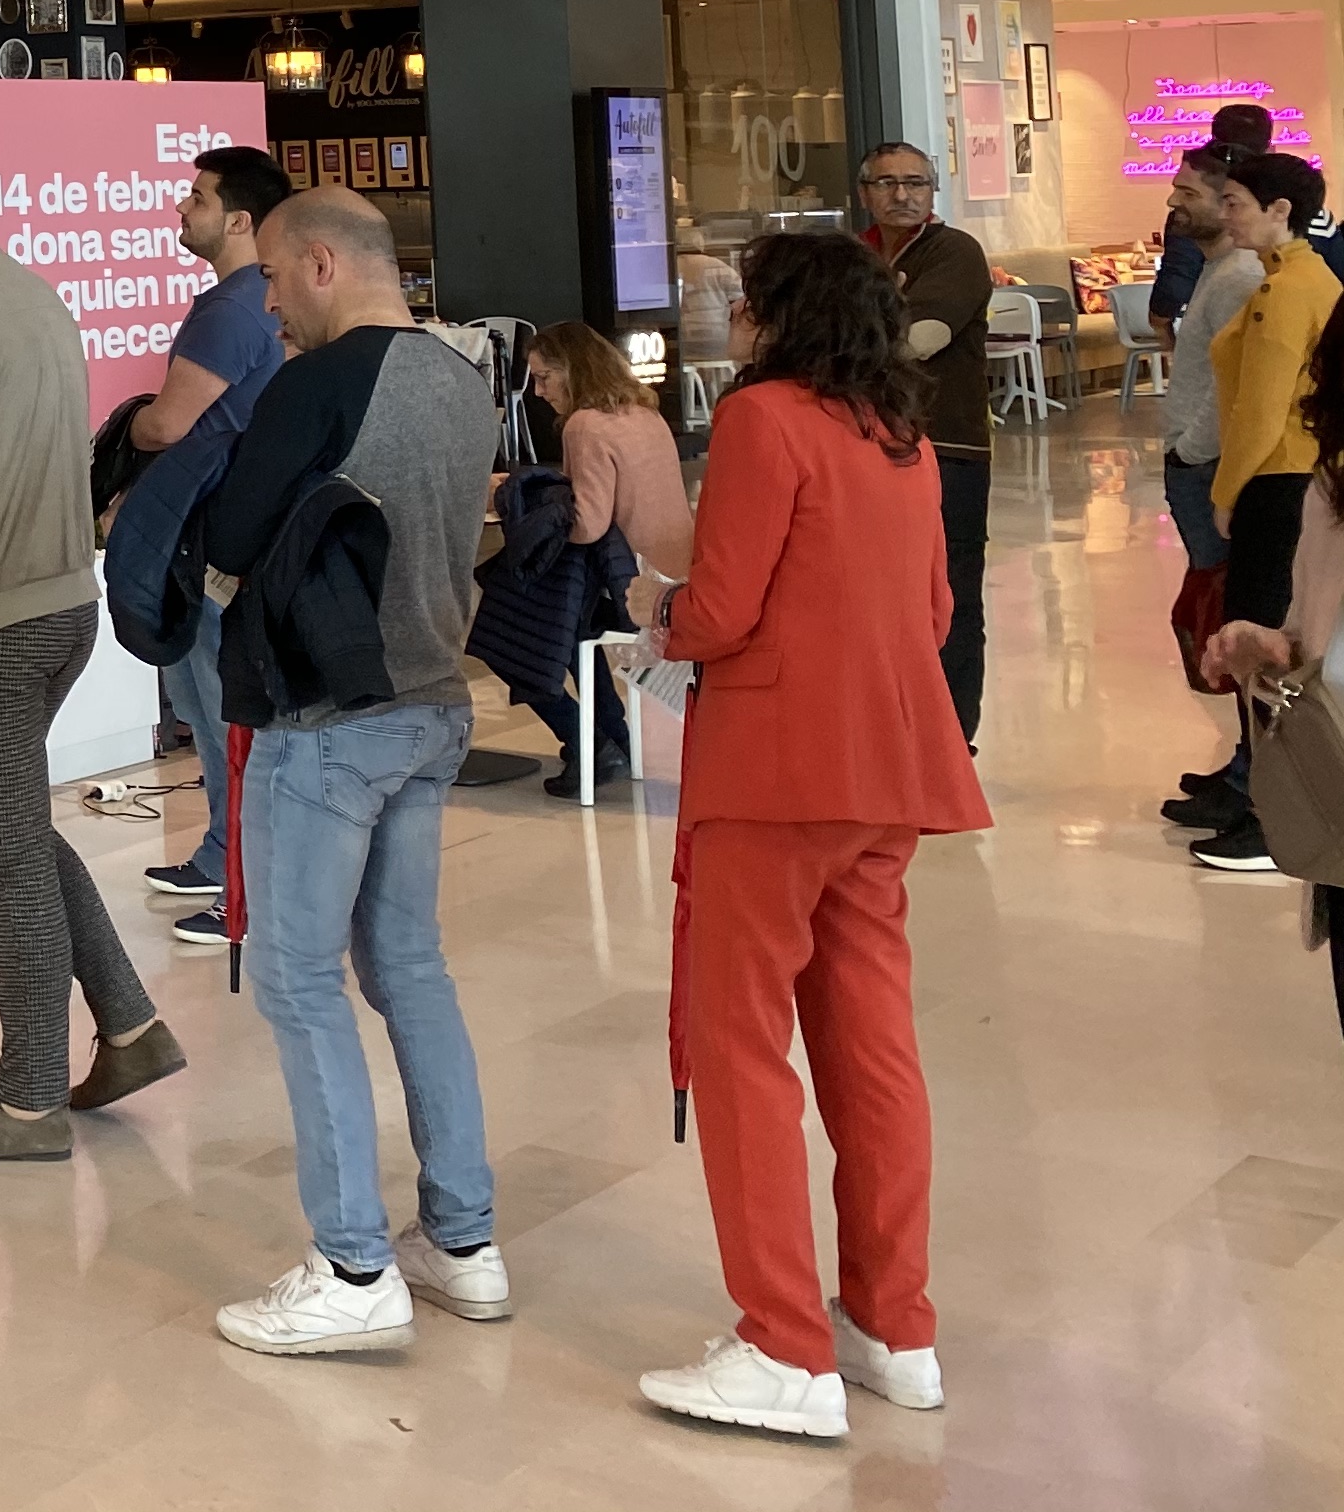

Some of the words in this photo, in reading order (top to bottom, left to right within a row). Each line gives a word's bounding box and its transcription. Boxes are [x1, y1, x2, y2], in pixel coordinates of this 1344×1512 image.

[156, 123, 232, 163] Este
[731, 115, 806, 185] 100
[39, 172, 87, 215] de
[7, 223, 104, 265] dona
[56, 268, 160, 321] quien
[628, 331, 666, 364] 100
